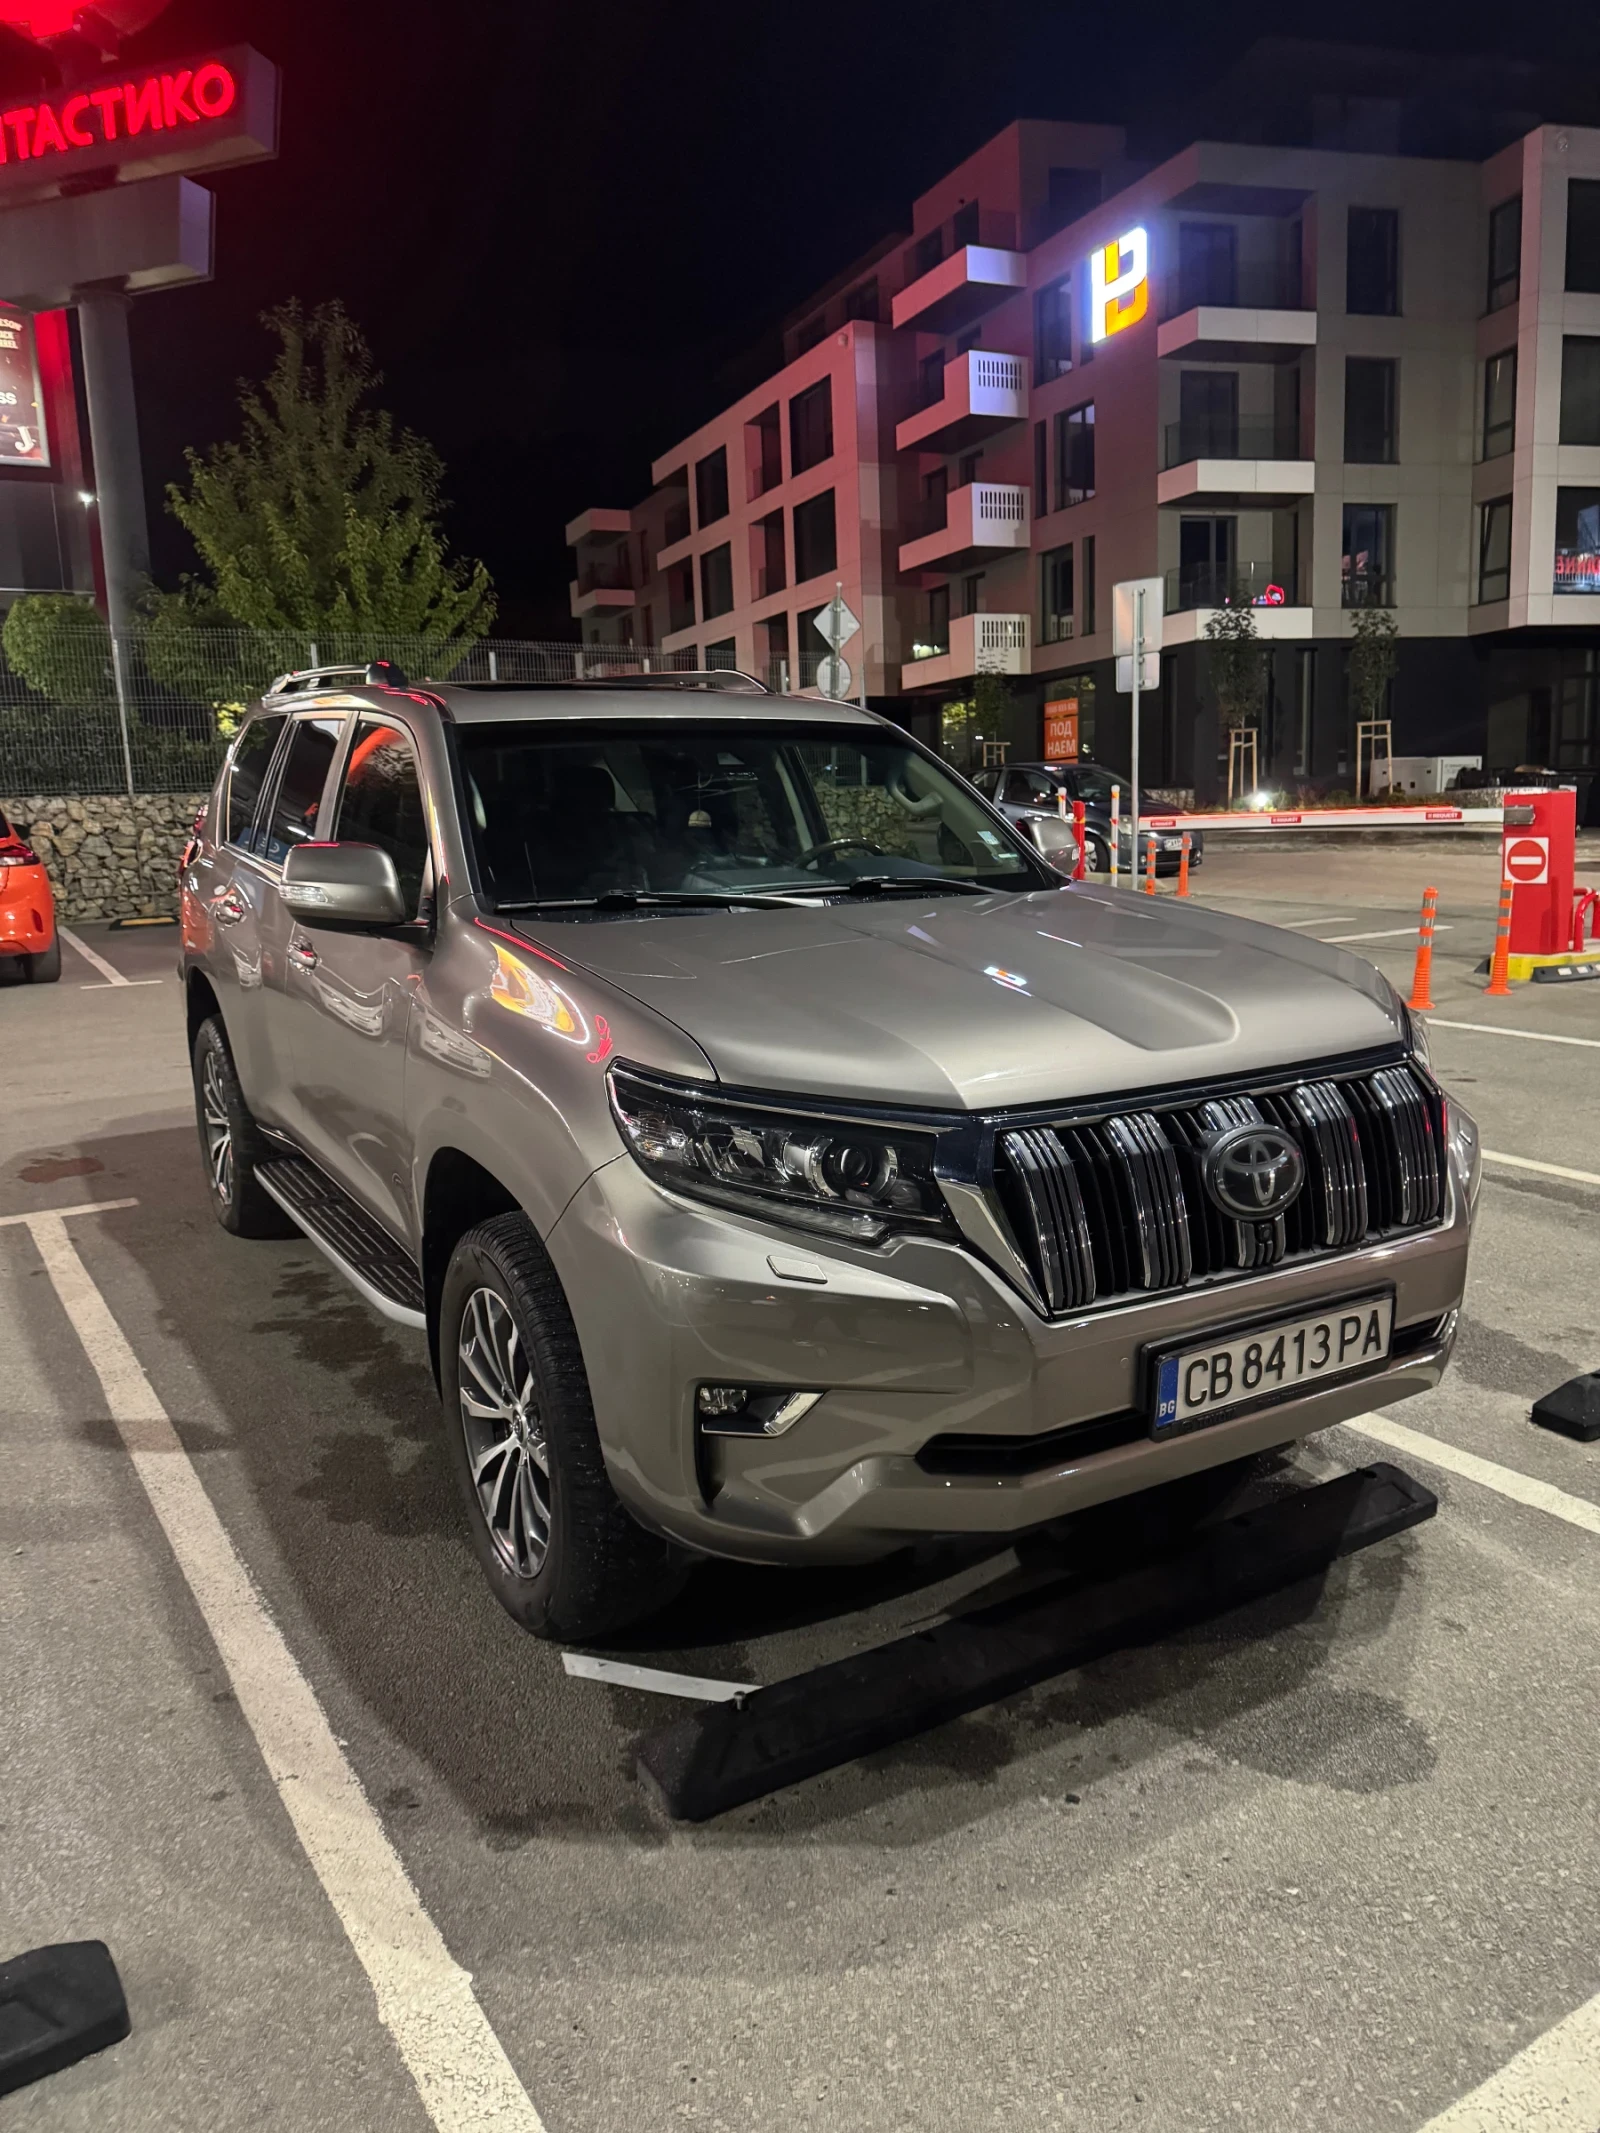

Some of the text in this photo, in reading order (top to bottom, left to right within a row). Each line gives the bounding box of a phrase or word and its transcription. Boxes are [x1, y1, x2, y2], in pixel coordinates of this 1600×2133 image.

[0, 63, 235, 165] ТАСТИКО
[1050, 721, 1072, 738] ПОД
[1047, 739, 1076, 756] НАЕМ
[1242, 1323, 1331, 1390] 8413
[1159, 1400, 1175, 1418] BG
